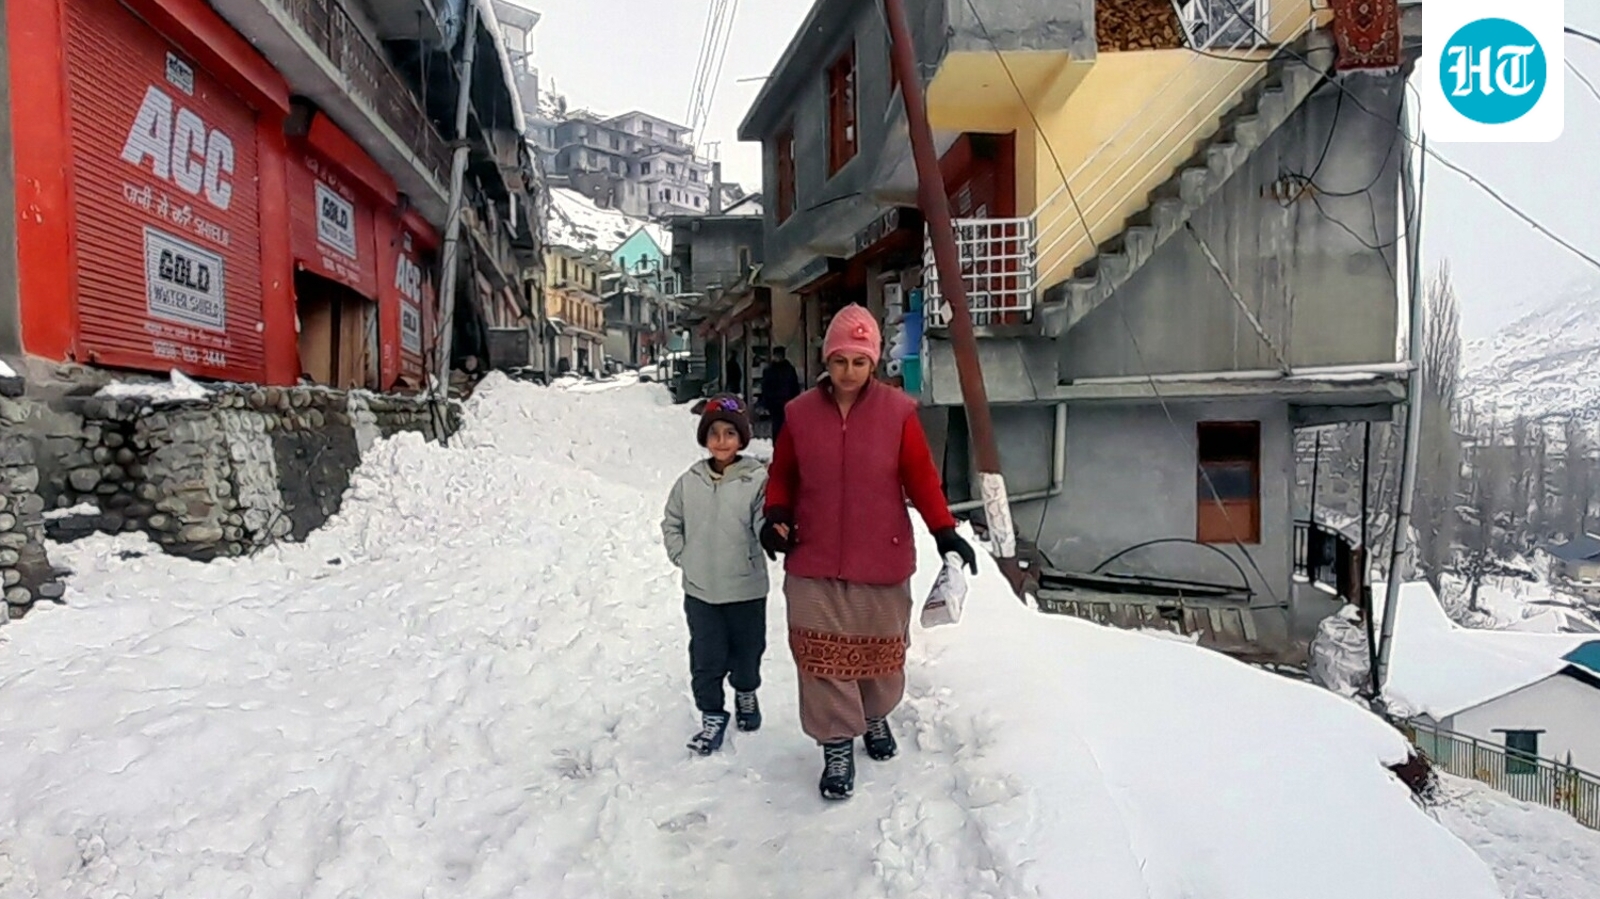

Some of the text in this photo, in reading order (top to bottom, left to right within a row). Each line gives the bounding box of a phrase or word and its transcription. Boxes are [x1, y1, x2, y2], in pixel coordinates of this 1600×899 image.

[120, 84, 234, 211] ACC
[321, 196, 348, 230] GOLD
[158, 248, 210, 293] GOLD
[395, 252, 422, 304] ACC
